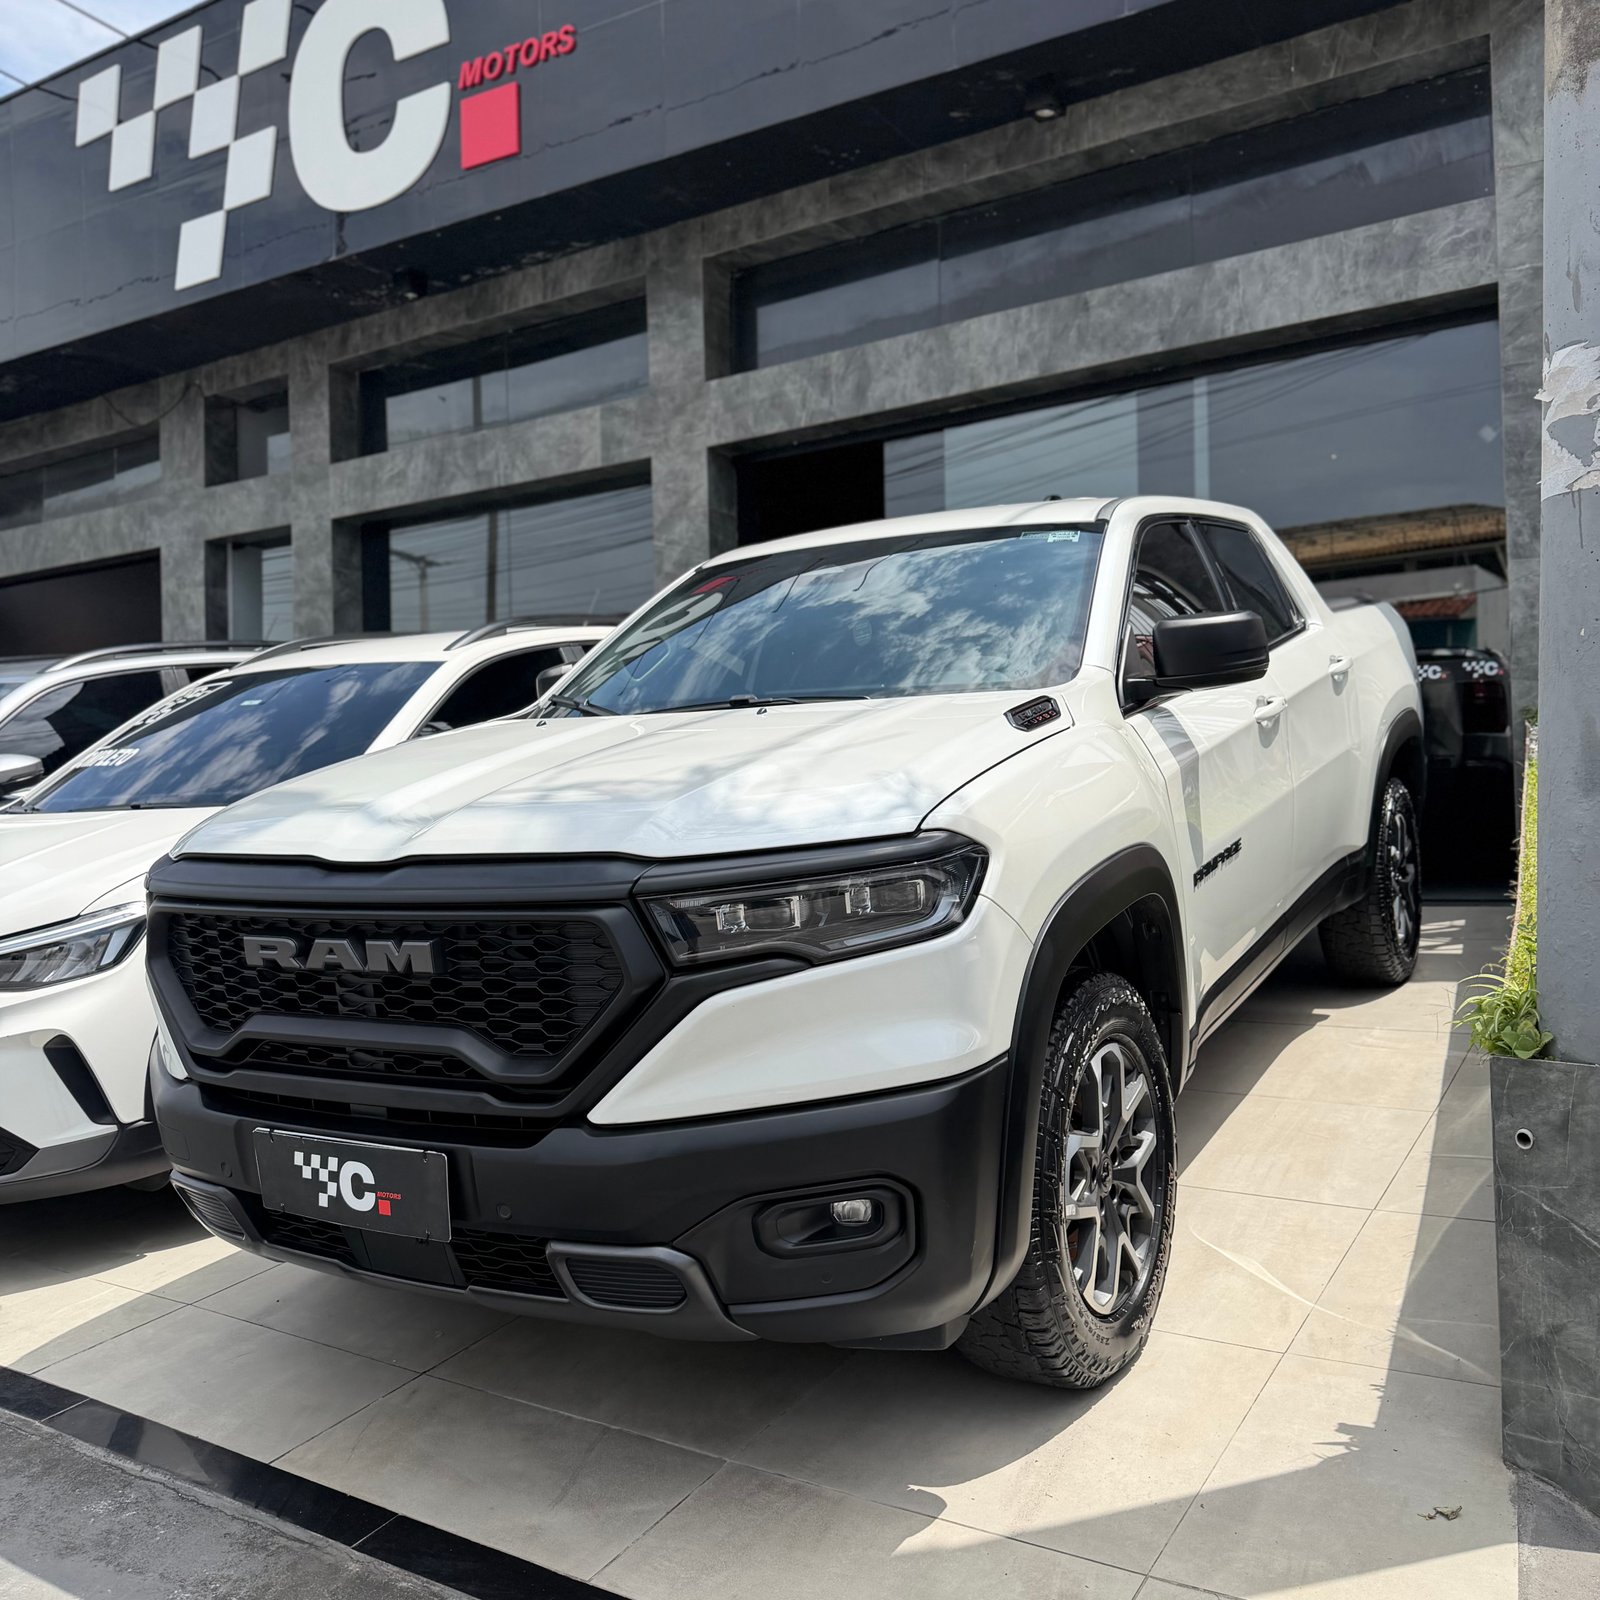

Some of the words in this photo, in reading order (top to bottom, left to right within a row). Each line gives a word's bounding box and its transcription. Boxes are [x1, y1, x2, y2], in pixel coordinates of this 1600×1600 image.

[458, 24, 576, 90] MOTORS
[243, 936, 434, 974] RAM
[377, 1191, 402, 1200] MOTORS
